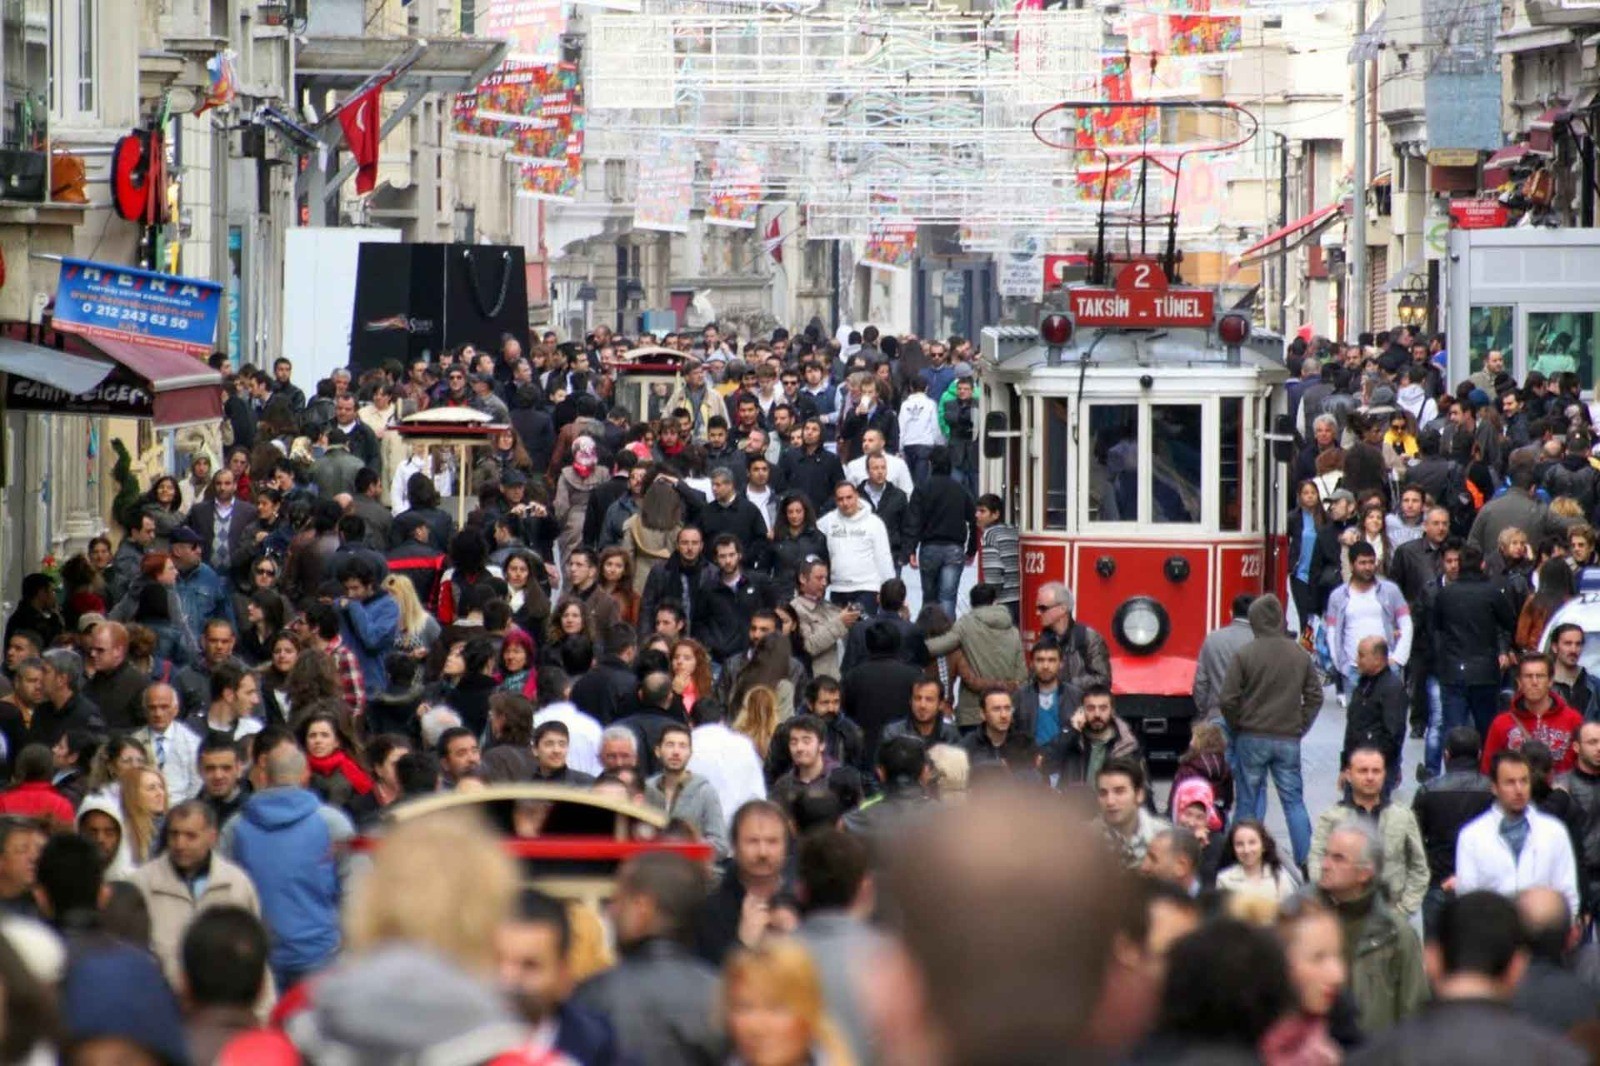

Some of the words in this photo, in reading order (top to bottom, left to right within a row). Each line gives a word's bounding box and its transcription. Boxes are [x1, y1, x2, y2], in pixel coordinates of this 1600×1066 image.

[1133, 264, 1150, 288] 2
[82, 302, 92, 314] 0
[95, 304, 119, 317] 212
[121, 308, 147, 322] 243
[150, 313, 167, 326] 62
[169, 317, 189, 330] 50
[1077, 295, 1130, 318] TAKSİM
[1154, 296, 1205, 318] TÜNEL
[1025, 552, 1045, 574] 223
[1241, 554, 1260, 577] 223
